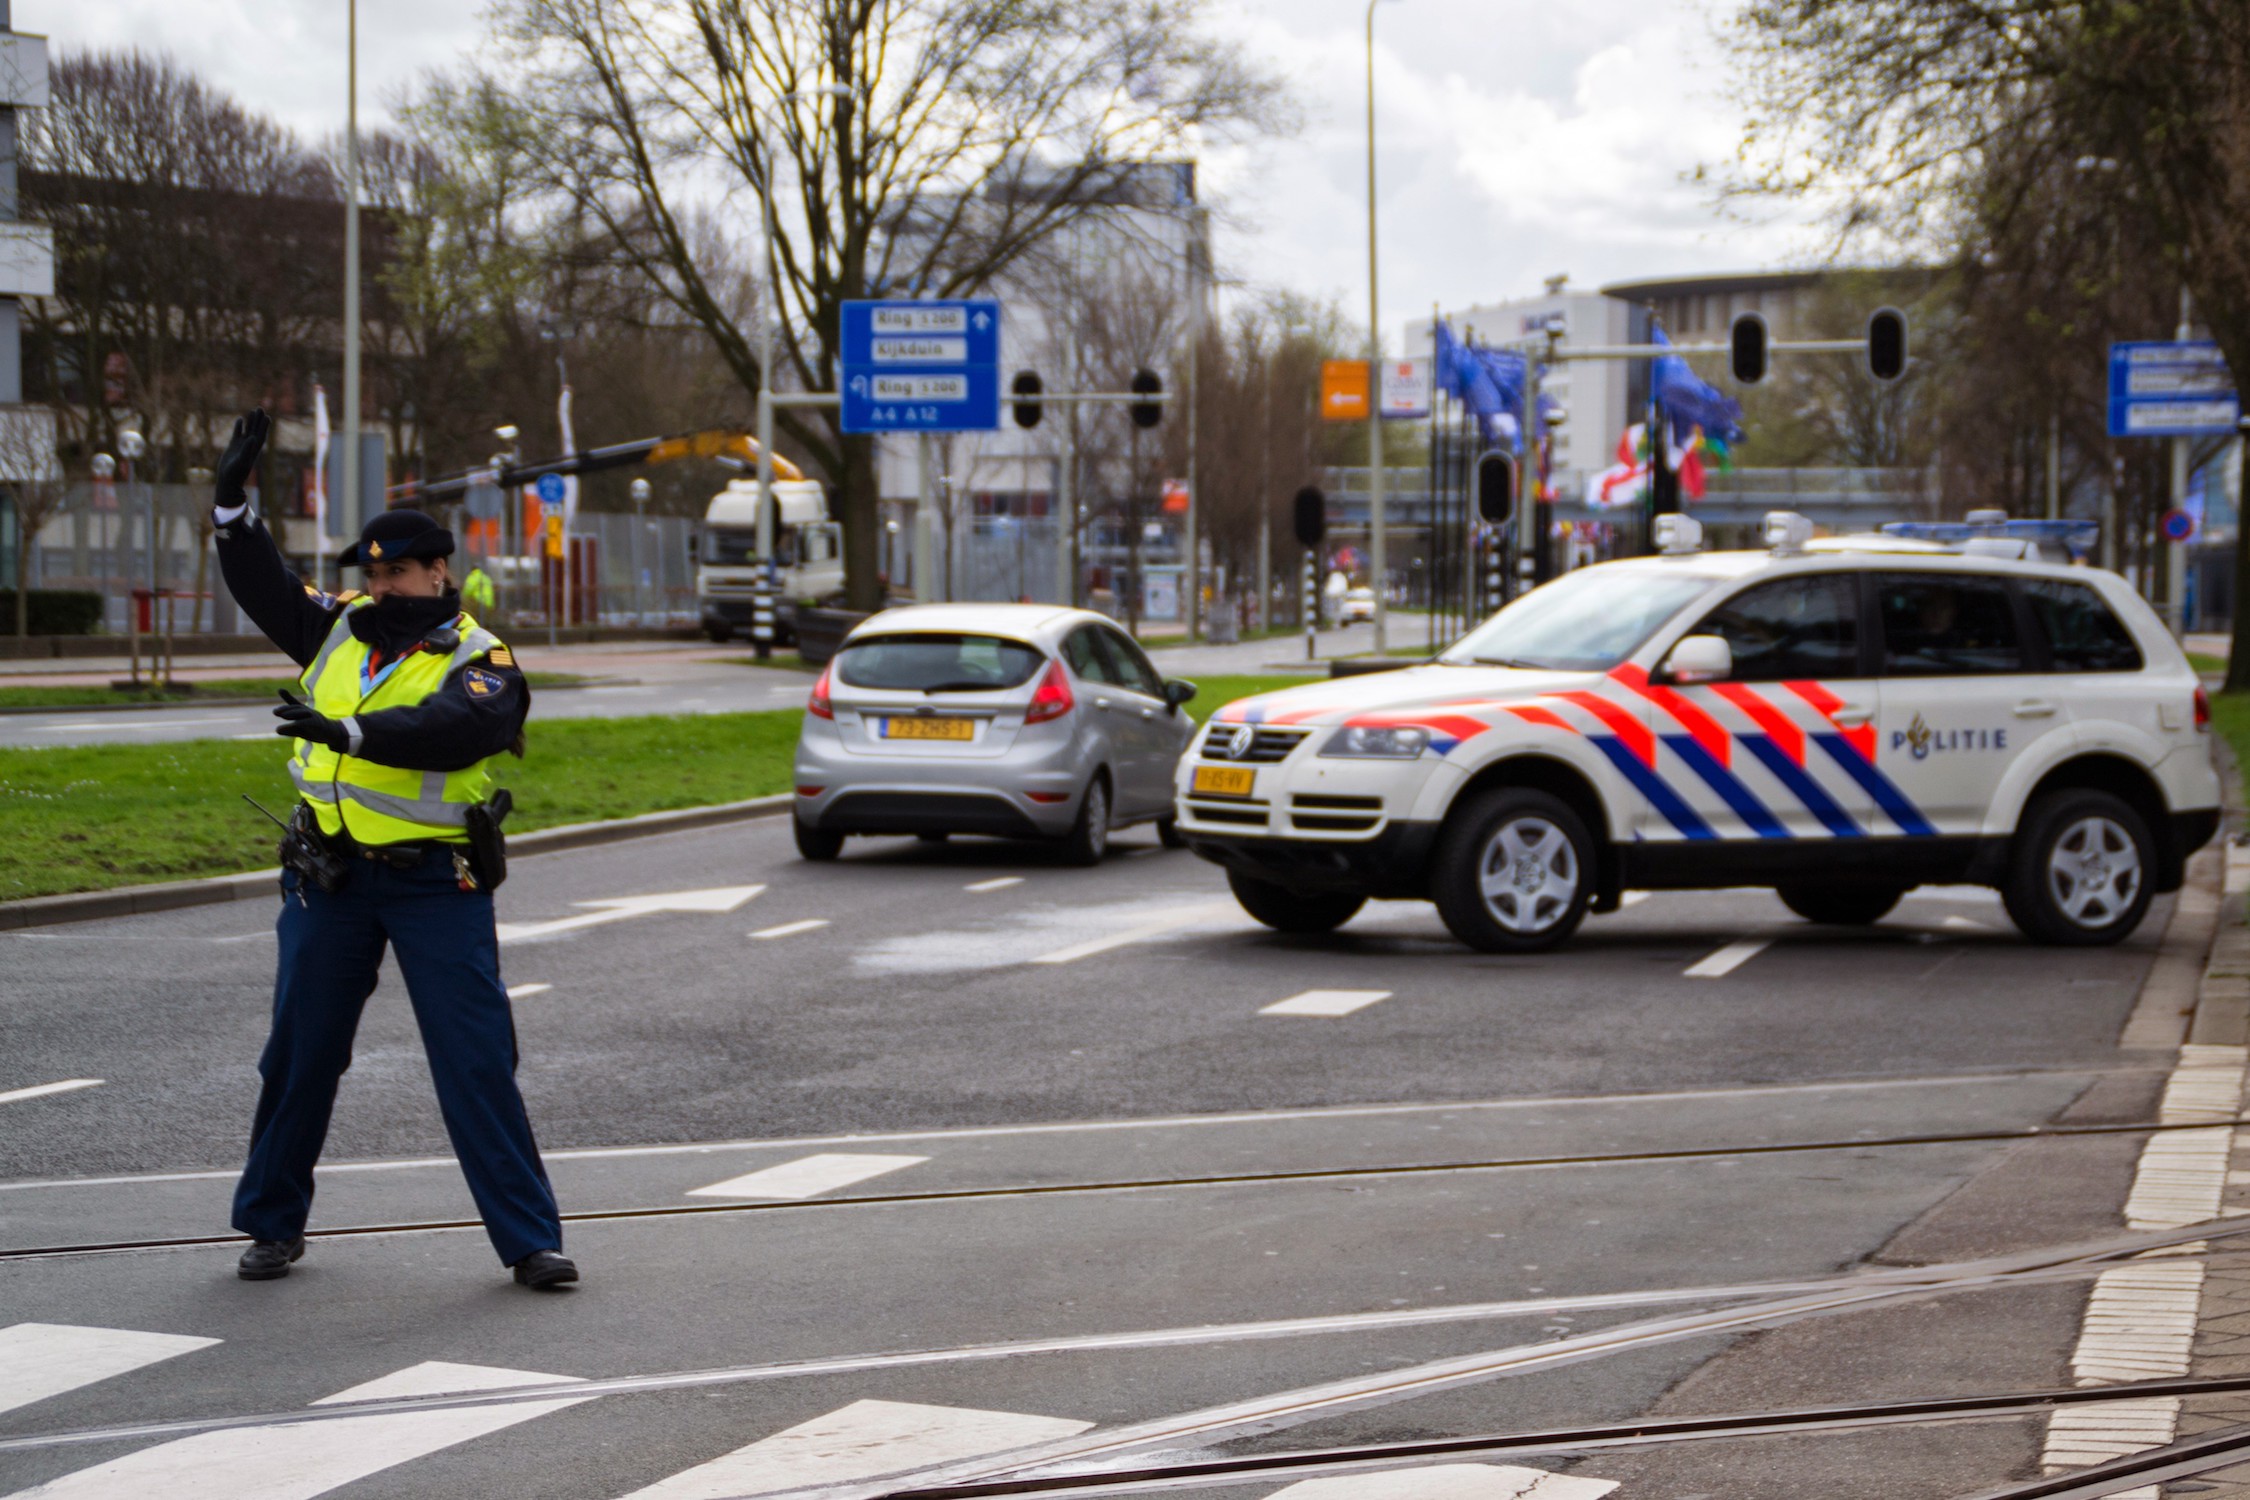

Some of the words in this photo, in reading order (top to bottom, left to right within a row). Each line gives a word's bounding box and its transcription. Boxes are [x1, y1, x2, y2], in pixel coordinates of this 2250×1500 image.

[878, 311, 912, 327] Ring
[877, 340, 944, 357] Kijkduin
[877, 379, 913, 396] Ring
[1892, 730, 2007, 760] POLITIE
